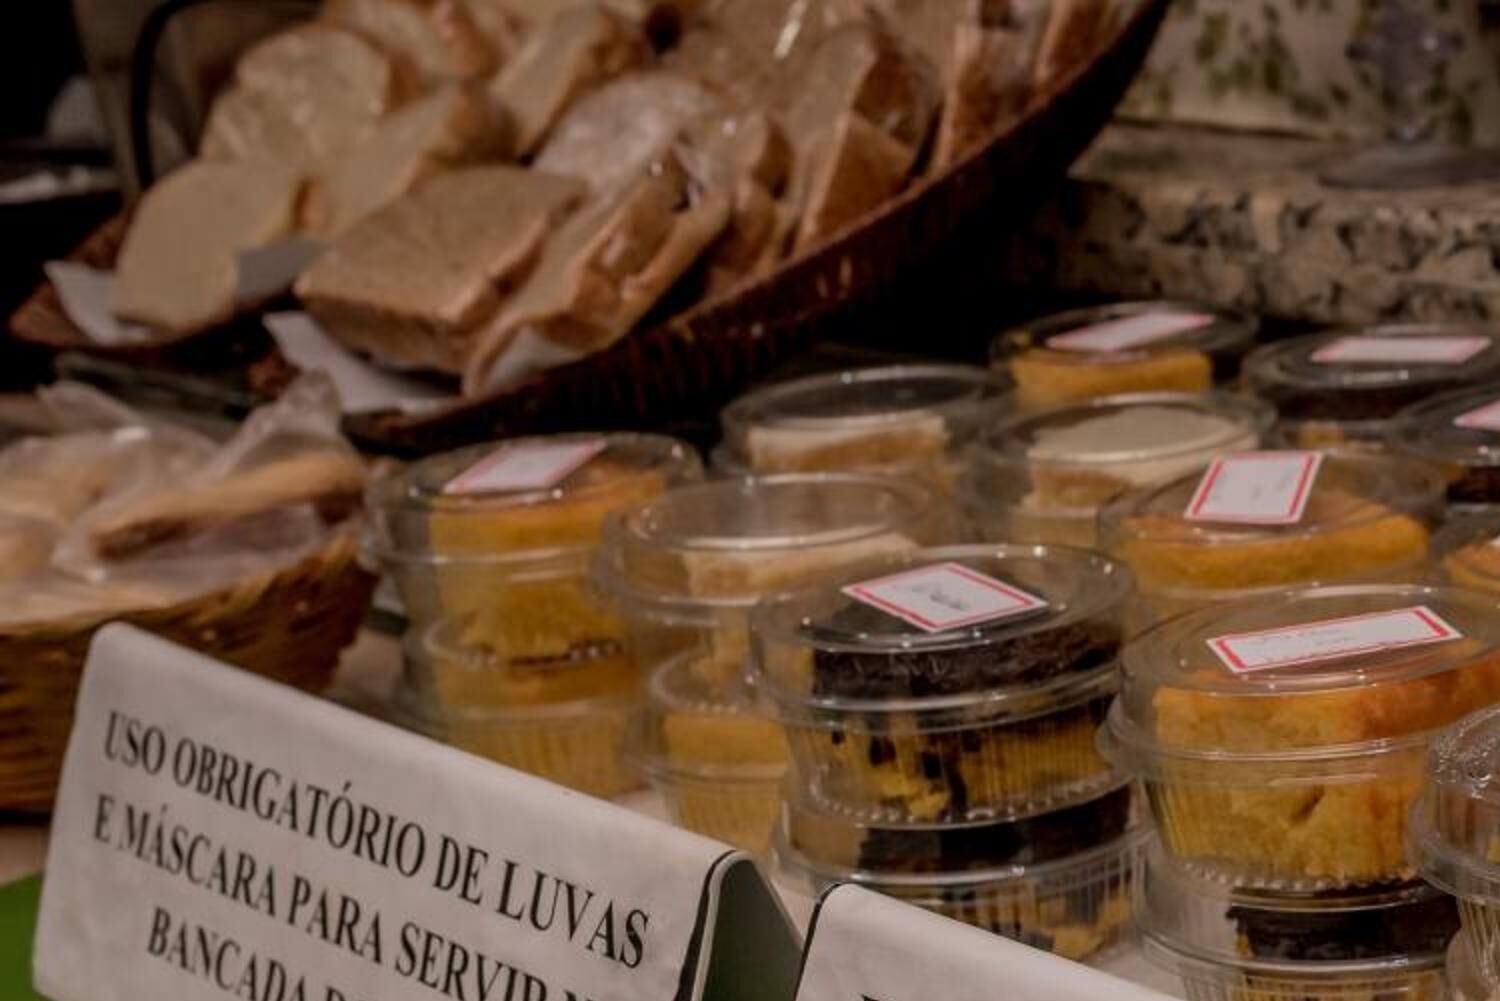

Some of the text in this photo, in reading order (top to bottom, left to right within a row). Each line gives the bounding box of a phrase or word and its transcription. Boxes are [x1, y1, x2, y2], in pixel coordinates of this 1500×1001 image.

[94, 794, 114, 842] E
[116, 803, 280, 920] MÁSCARA
[287, 875, 383, 966] PARA
[104, 711, 649, 970] USO OBRIGATÓRIO DE LUVAS
